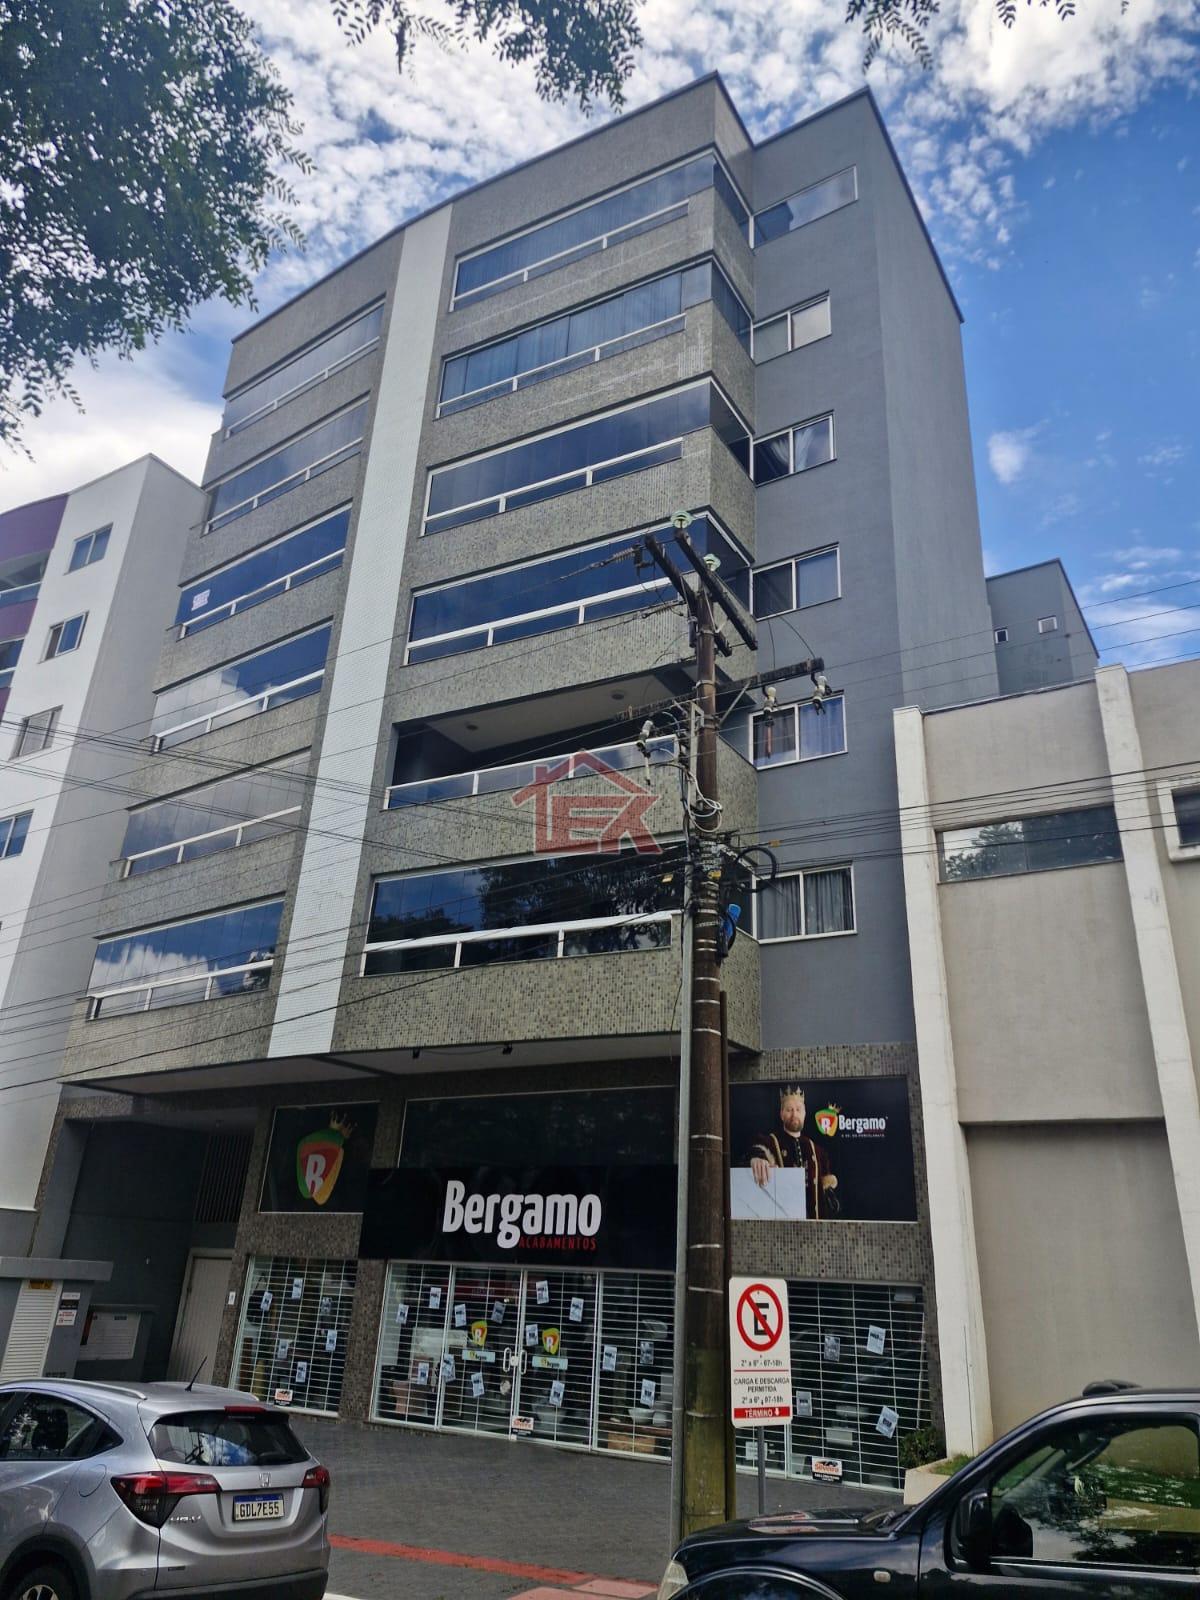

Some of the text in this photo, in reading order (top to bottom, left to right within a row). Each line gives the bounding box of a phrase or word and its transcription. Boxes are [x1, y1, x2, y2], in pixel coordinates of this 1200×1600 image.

[838, 1115, 885, 1133] Bergamo
[442, 1180, 602, 1249] Bergamo
[518, 1236, 597, 1250] ACABAMENTOS
[733, 1377, 754, 1385] CARGA
[760, 1377, 790, 1385] DESCARGA
[747, 1385, 777, 1393] PERMITIDA
[239, 1502, 280, 1517] GDL7E55
